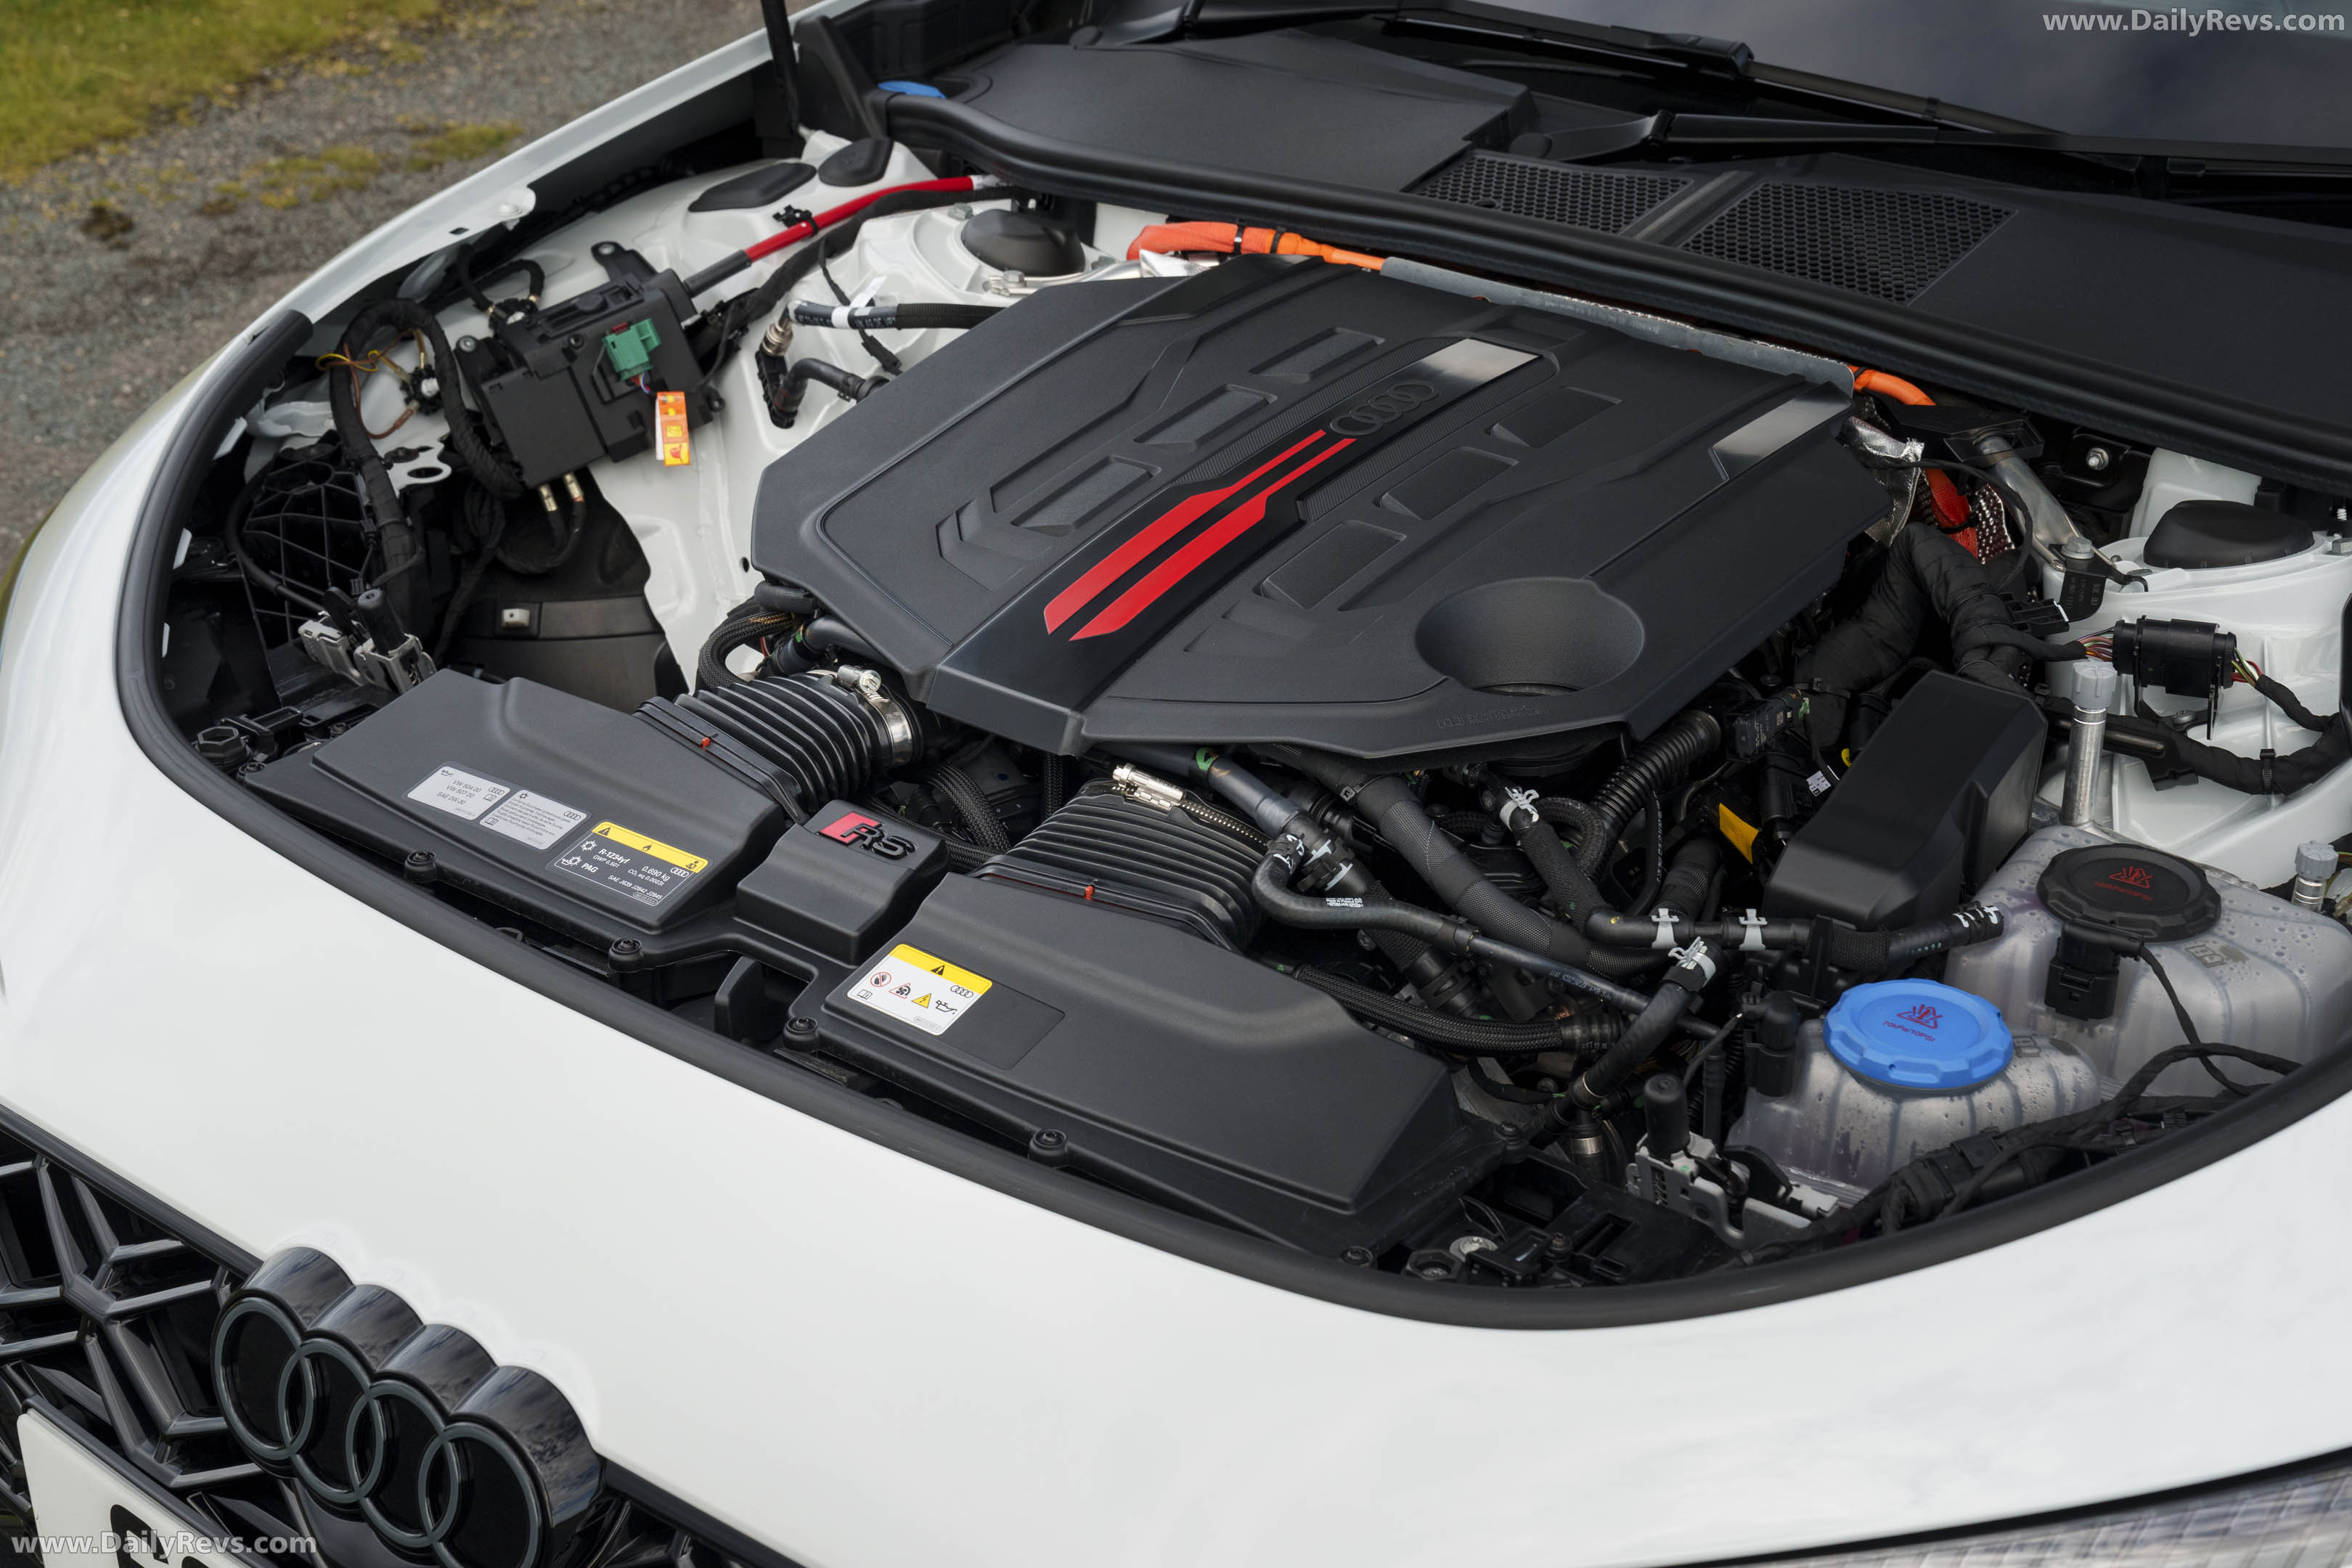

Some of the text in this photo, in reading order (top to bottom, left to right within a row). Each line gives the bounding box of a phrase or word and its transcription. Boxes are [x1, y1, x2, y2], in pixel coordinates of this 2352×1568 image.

[839, 822, 916, 860] RS
[581, 862, 599, 873] PAG
[619, 879, 633, 888] J639
[598, 849, 671, 882] R-1234yf 0.690 kg
[605, 859, 620, 868] 0.501
